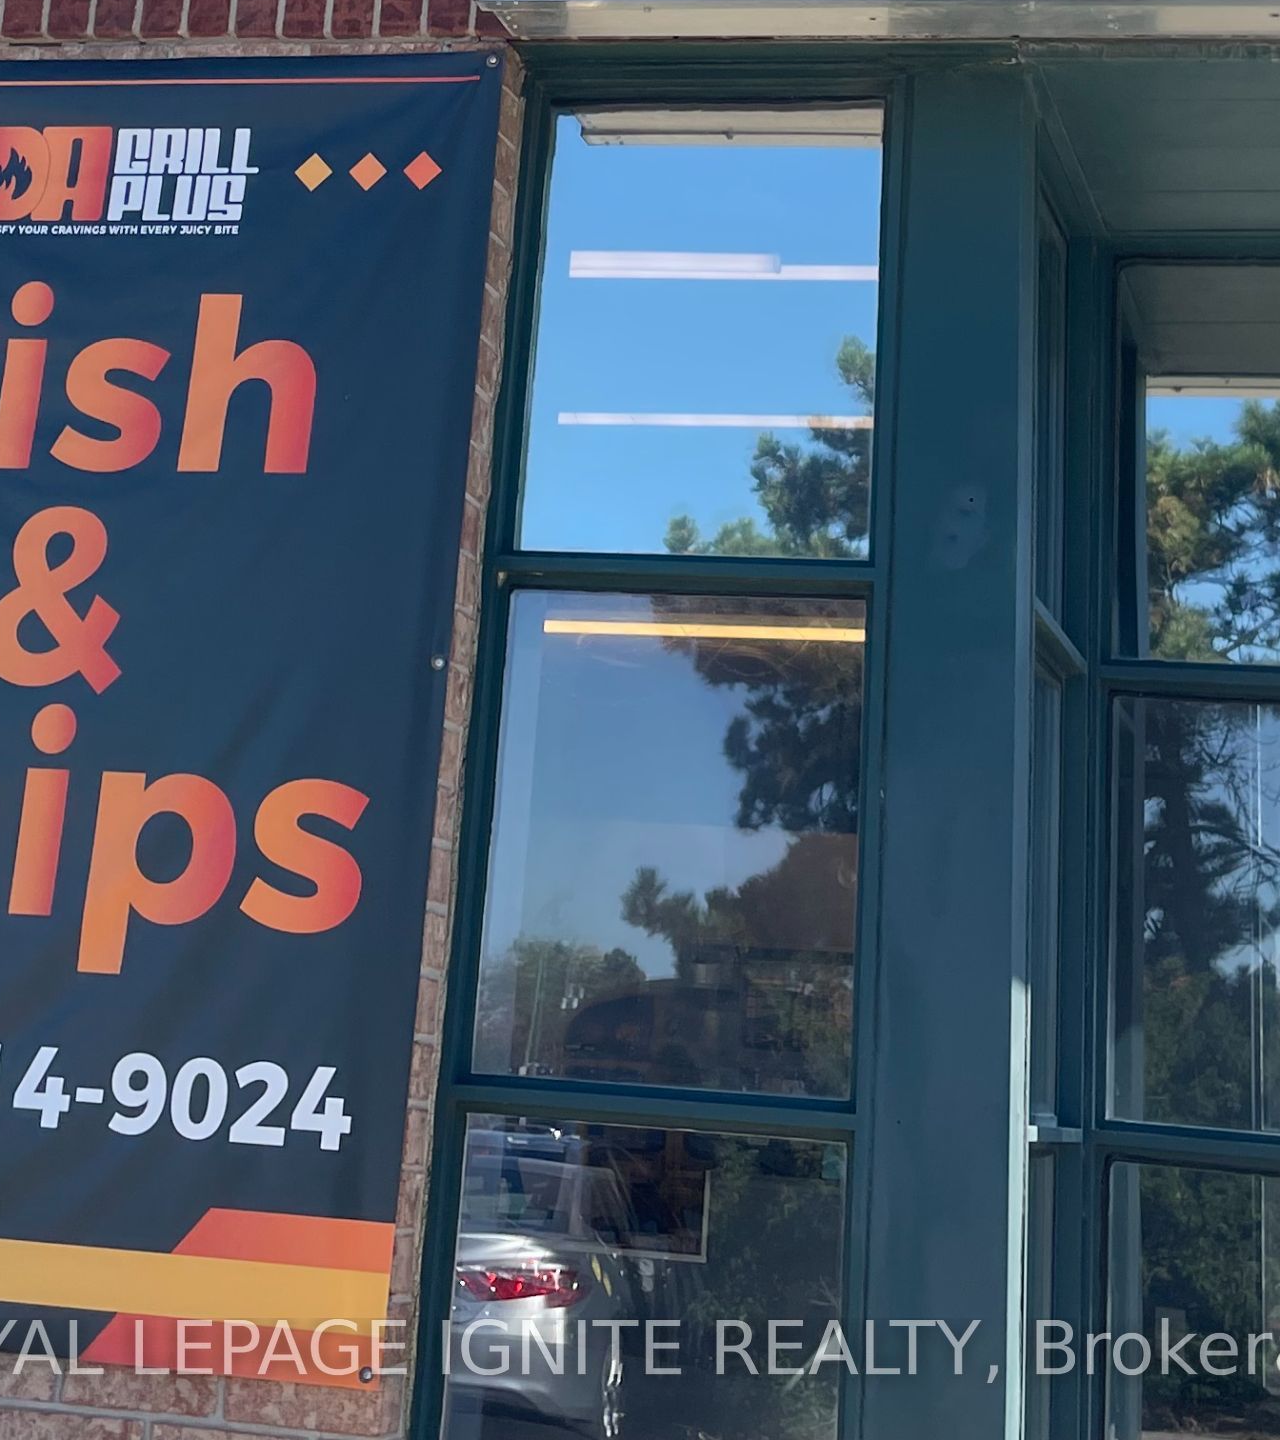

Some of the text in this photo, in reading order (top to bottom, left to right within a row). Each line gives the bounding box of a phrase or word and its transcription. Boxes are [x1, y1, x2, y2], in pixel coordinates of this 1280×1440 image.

[114, 128, 259, 174] GRILL
[107, 175, 247, 221] PLUS
[18, 224, 49, 235] YOUR
[51, 224, 106, 235] CRAVINGS
[109, 224, 138, 235] WITH
[140, 224, 177, 235] EVERY
[179, 224, 211, 235] JUICY
[214, 224, 239, 235] BITE
